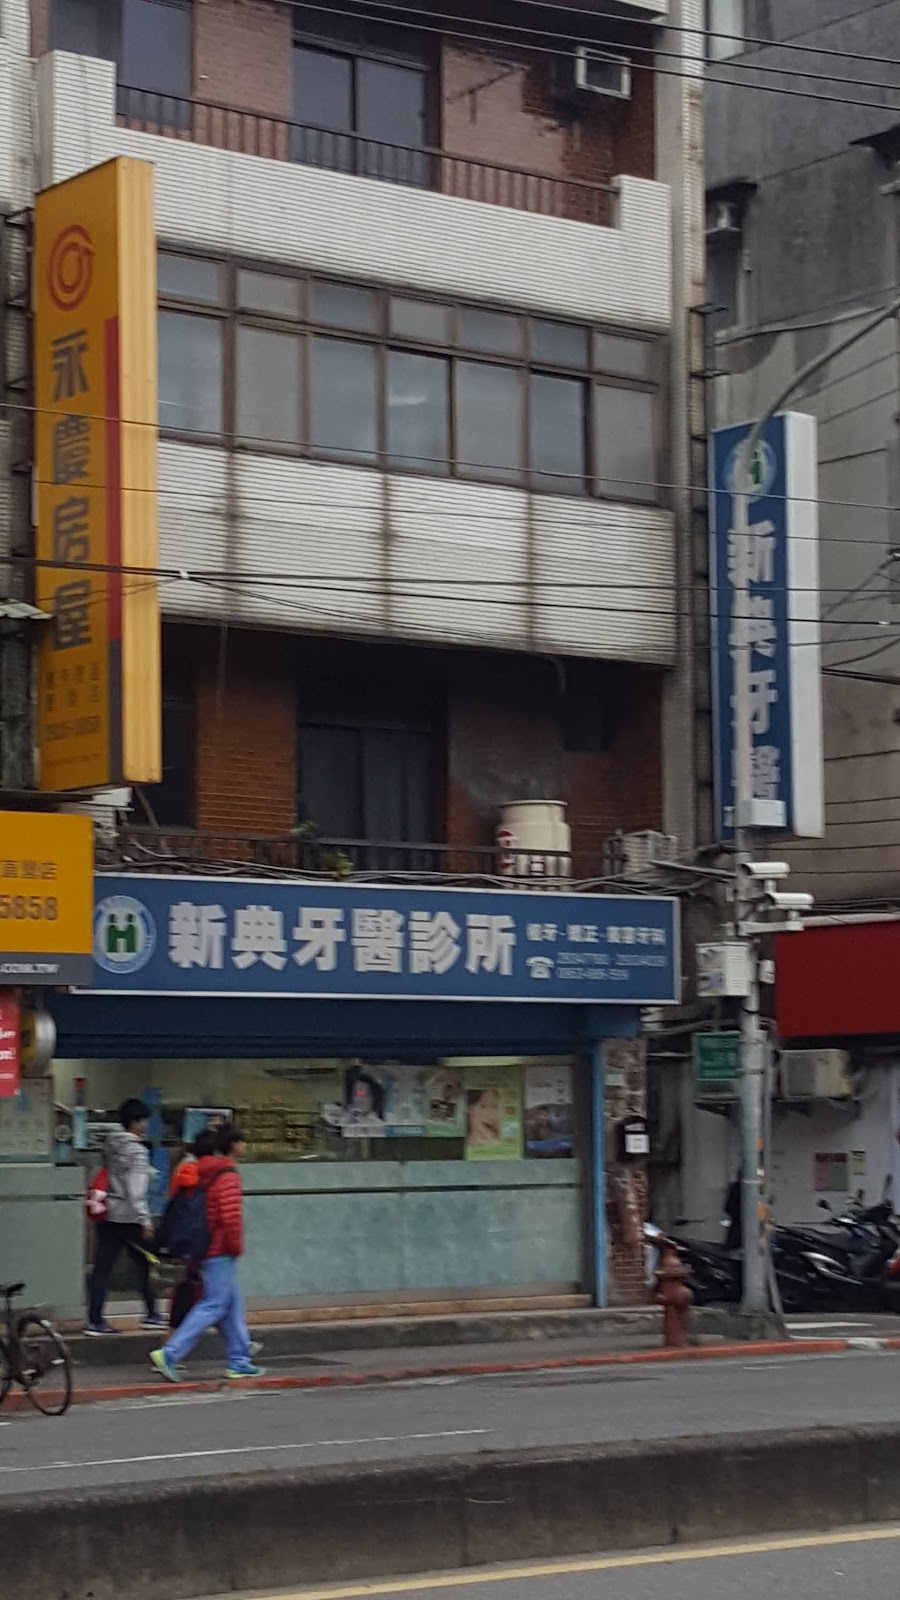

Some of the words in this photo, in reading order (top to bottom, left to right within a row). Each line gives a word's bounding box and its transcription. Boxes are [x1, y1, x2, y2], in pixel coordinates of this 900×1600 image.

[52, 329, 92, 650] 永慶房屋
[168, 902, 517, 977] 新典牙醫診所
